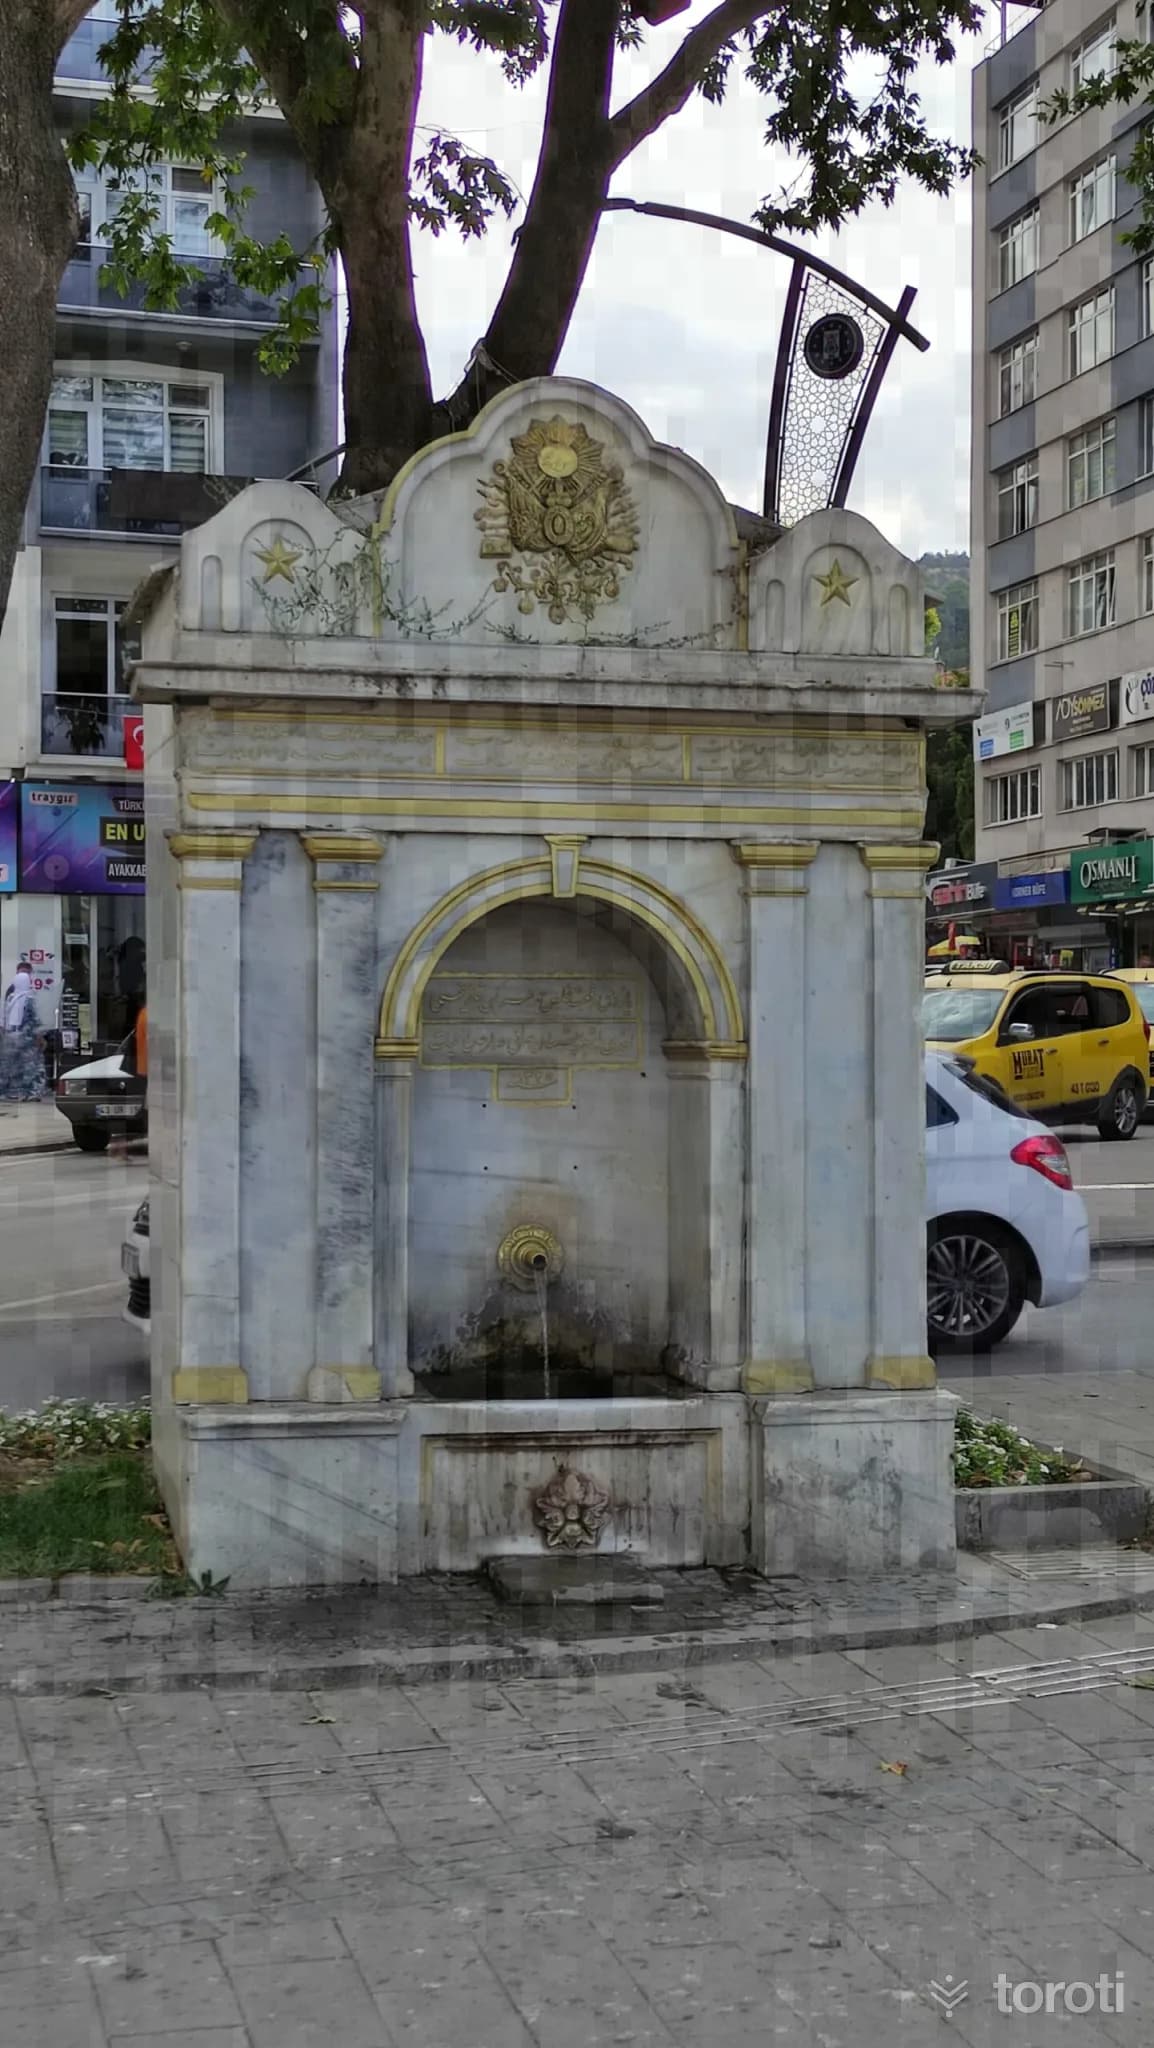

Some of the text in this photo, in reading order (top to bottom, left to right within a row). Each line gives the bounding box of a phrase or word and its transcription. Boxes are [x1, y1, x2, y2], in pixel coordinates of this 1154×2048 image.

[105, 823, 128, 840] EN
[1081, 855, 1136, 888] OSMANLI
[1012, 1048, 1044, 1074] MURAT
